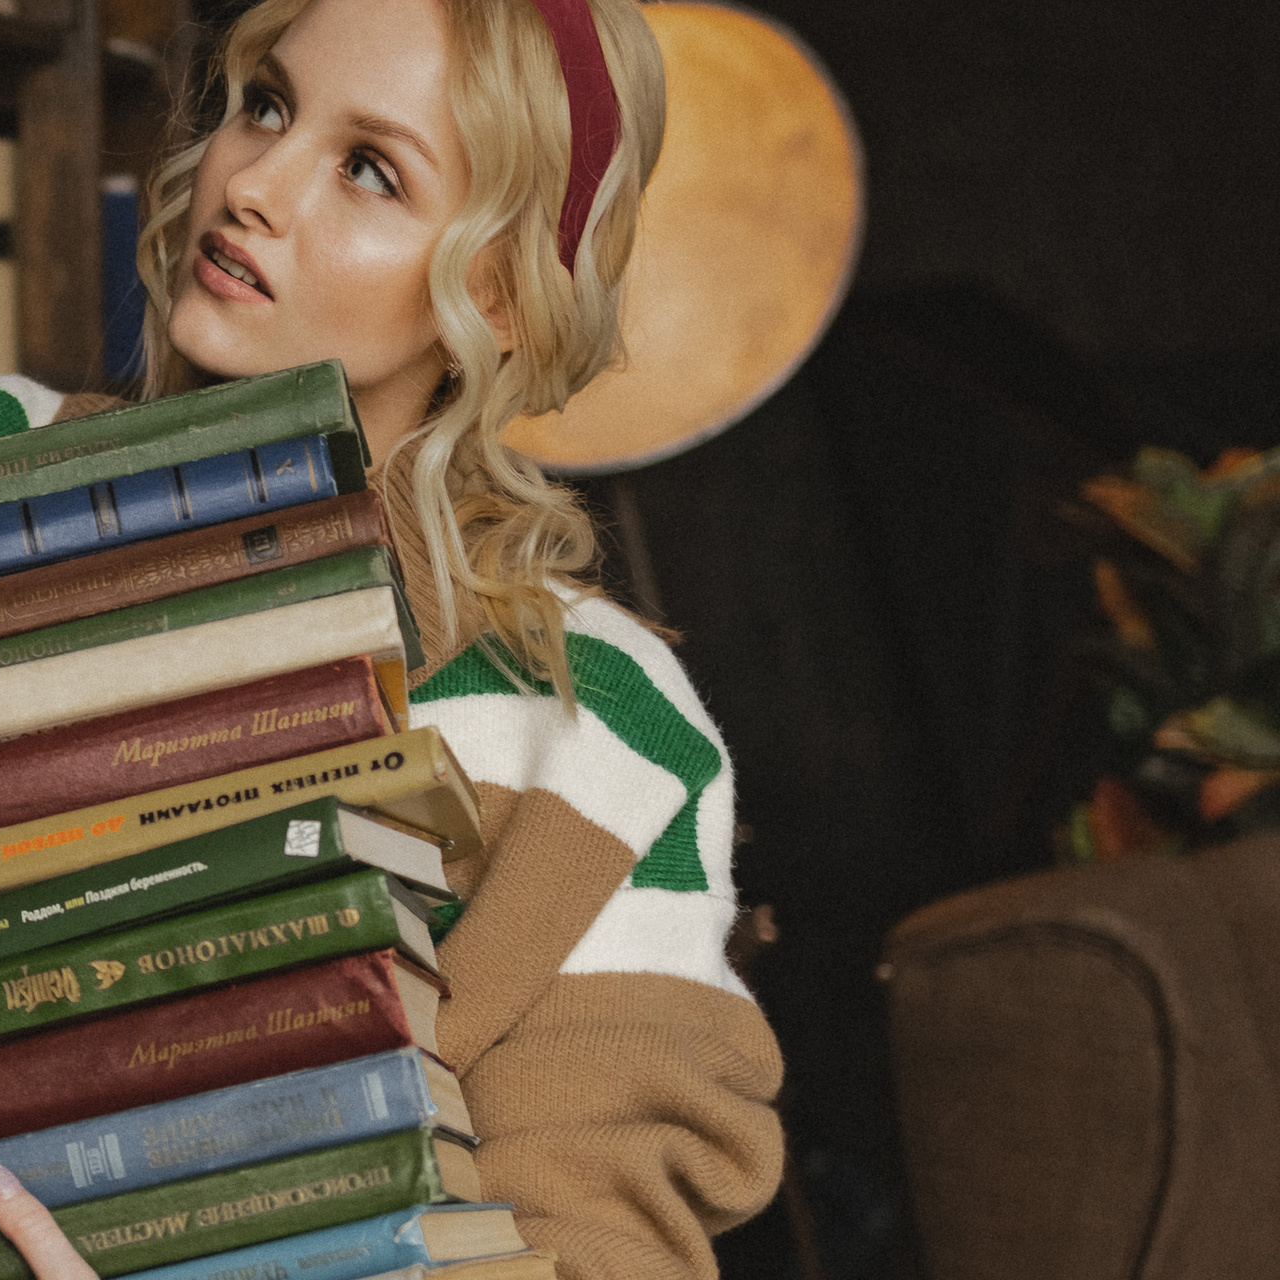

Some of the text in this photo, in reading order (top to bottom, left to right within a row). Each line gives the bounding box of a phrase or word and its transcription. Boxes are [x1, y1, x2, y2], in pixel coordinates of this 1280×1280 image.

[111, 725, 243, 767] Мариэтта
[250, 700, 356, 737] Шагинян
[20, 902, 65, 924] Роддом,
[64, 895, 86, 911] или
[84, 883, 131, 905] Поздняя
[137, 913, 331, 975] ШАХМАГОНОВ
[127, 998, 370, 1070] Мариэтта Шагинян
[76, 1165, 393, 1254] ПРОИСХОЖДЕНИЕ МАСТЕРА
